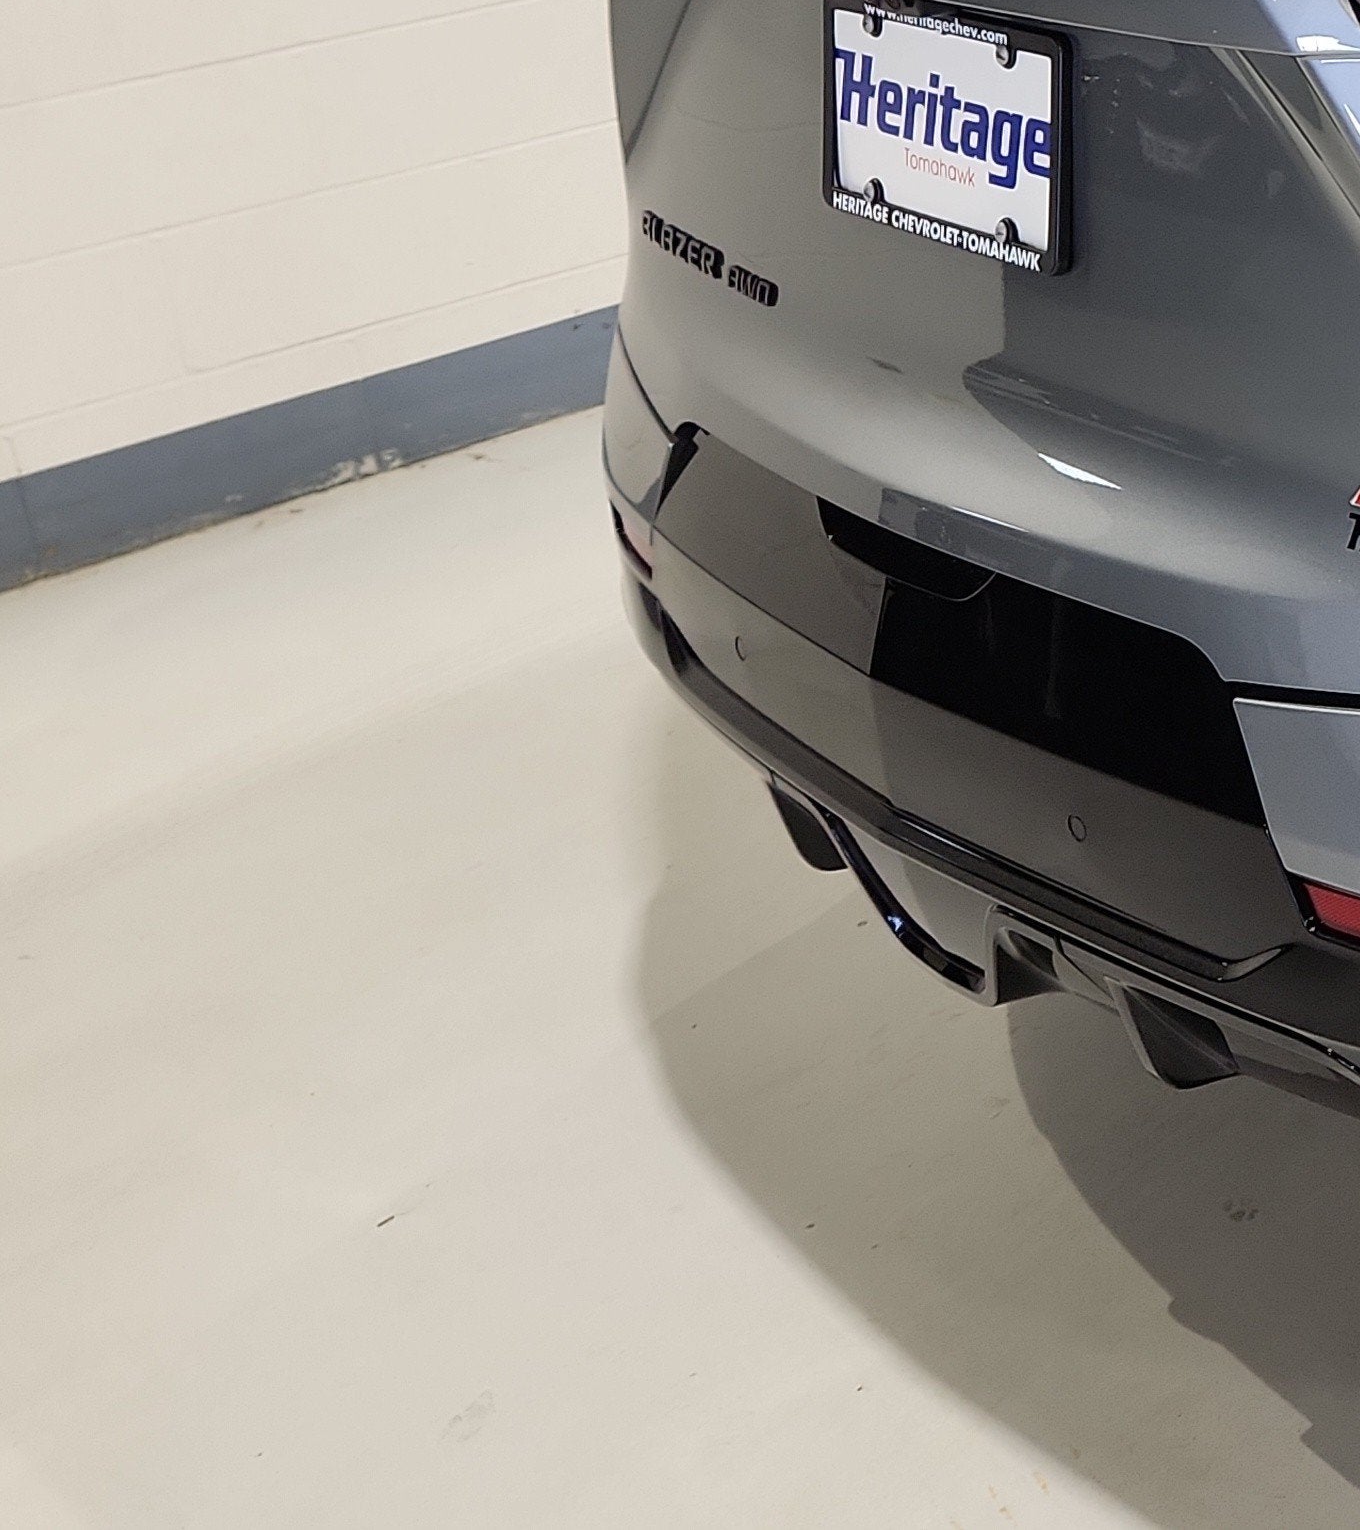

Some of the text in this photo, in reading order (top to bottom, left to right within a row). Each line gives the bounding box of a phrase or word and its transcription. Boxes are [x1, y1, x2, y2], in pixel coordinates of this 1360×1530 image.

[834, 47, 1051, 190] Heritage
[903, 147, 975, 188] Tomahawk
[832, 191, 889, 224] HERITAGE
[642, 210, 780, 307] BLAZER AWD
